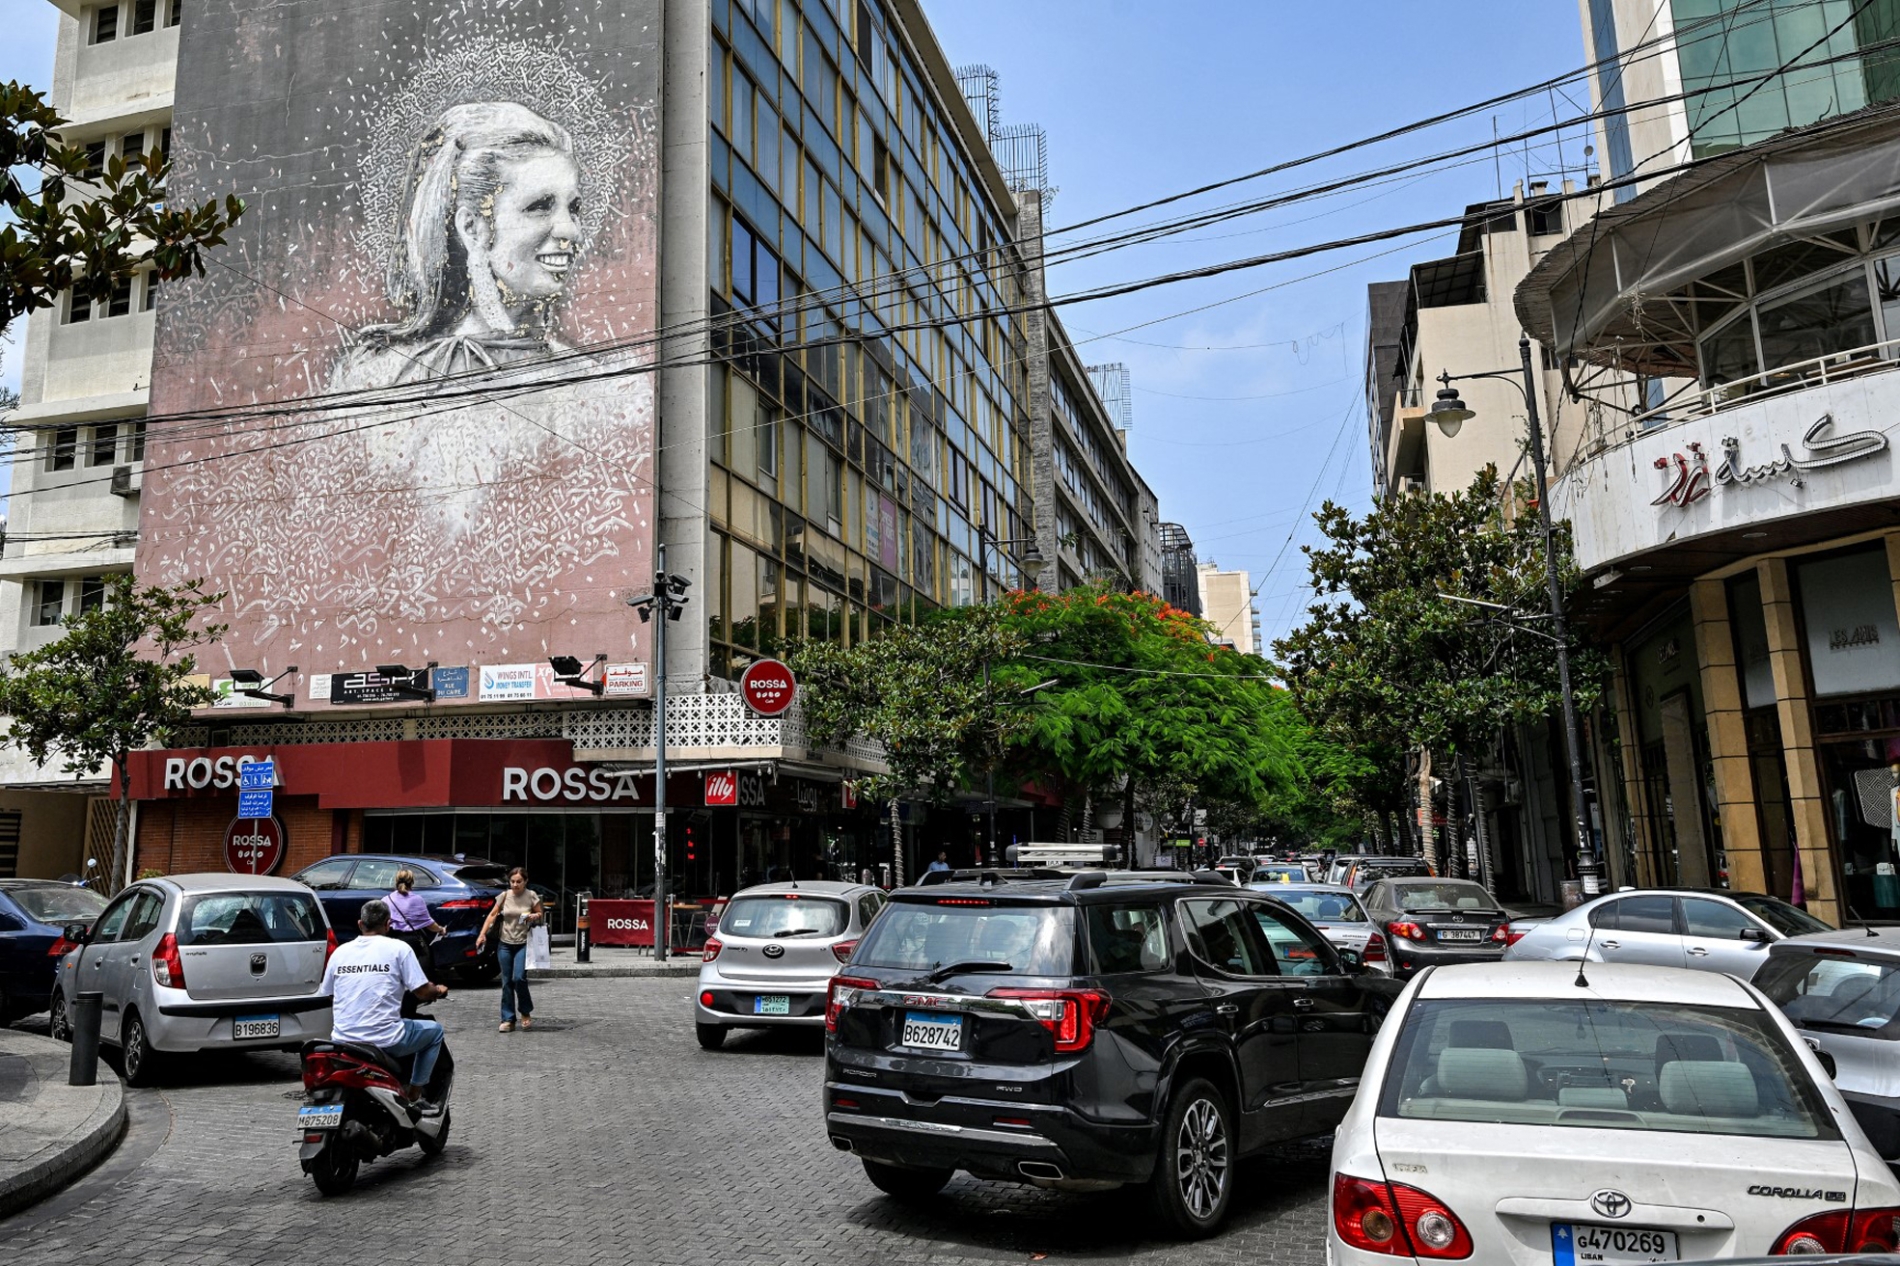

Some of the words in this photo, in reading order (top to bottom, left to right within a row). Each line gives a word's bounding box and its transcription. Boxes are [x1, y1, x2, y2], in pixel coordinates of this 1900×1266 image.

[497, 671, 517, 680] WINGS
[609, 668, 643, 677] موقف
[511, 681, 532, 689] TRANSFER
[750, 679, 787, 689] ROSSA
[503, 767, 640, 800] ROSSA
[708, 775, 733, 801] illy
[233, 836, 272, 846] ROSSA
[607, 919, 648, 930] ROSSA
[337, 964, 390, 974] ESSENTIALS
[904, 995, 947, 1008] GMC
[235, 1022, 278, 1037] B196836
[904, 1024, 960, 1047] B628742
[1747, 1185, 1823, 1200] COROLLA
[1581, 1253, 1603, 1261] LIBAN
